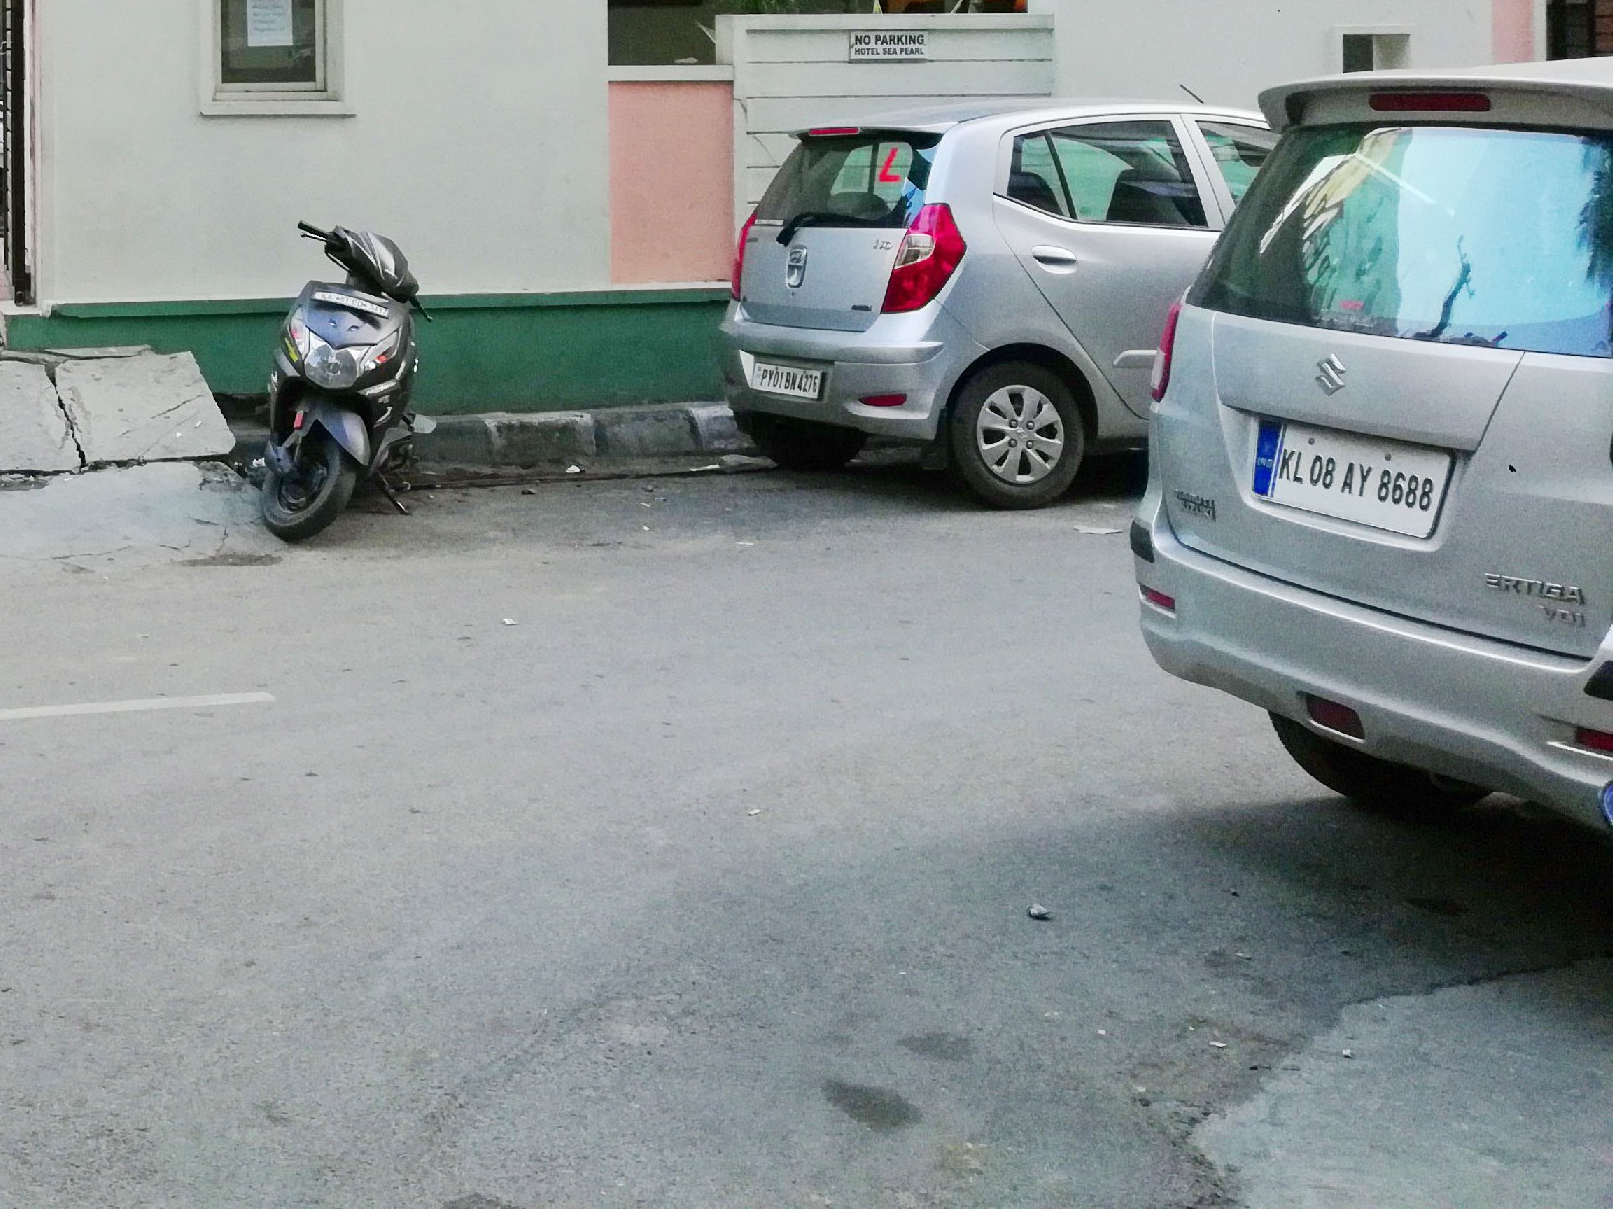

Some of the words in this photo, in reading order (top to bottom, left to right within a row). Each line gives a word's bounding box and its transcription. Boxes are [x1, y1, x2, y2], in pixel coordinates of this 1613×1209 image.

[854, 47, 881, 56] HOTEL
[882, 47, 898, 56] SEA
[899, 47, 925, 56] PEARL
[855, 34, 871, 46] NO
[874, 34, 925, 46] PARKING
[879, 147, 902, 182] L
[1279, 448, 1304, 485] KL
[1309, 455, 1336, 490] 08
[1341, 461, 1373, 497] AY
[1377, 469, 1435, 512] 8688
